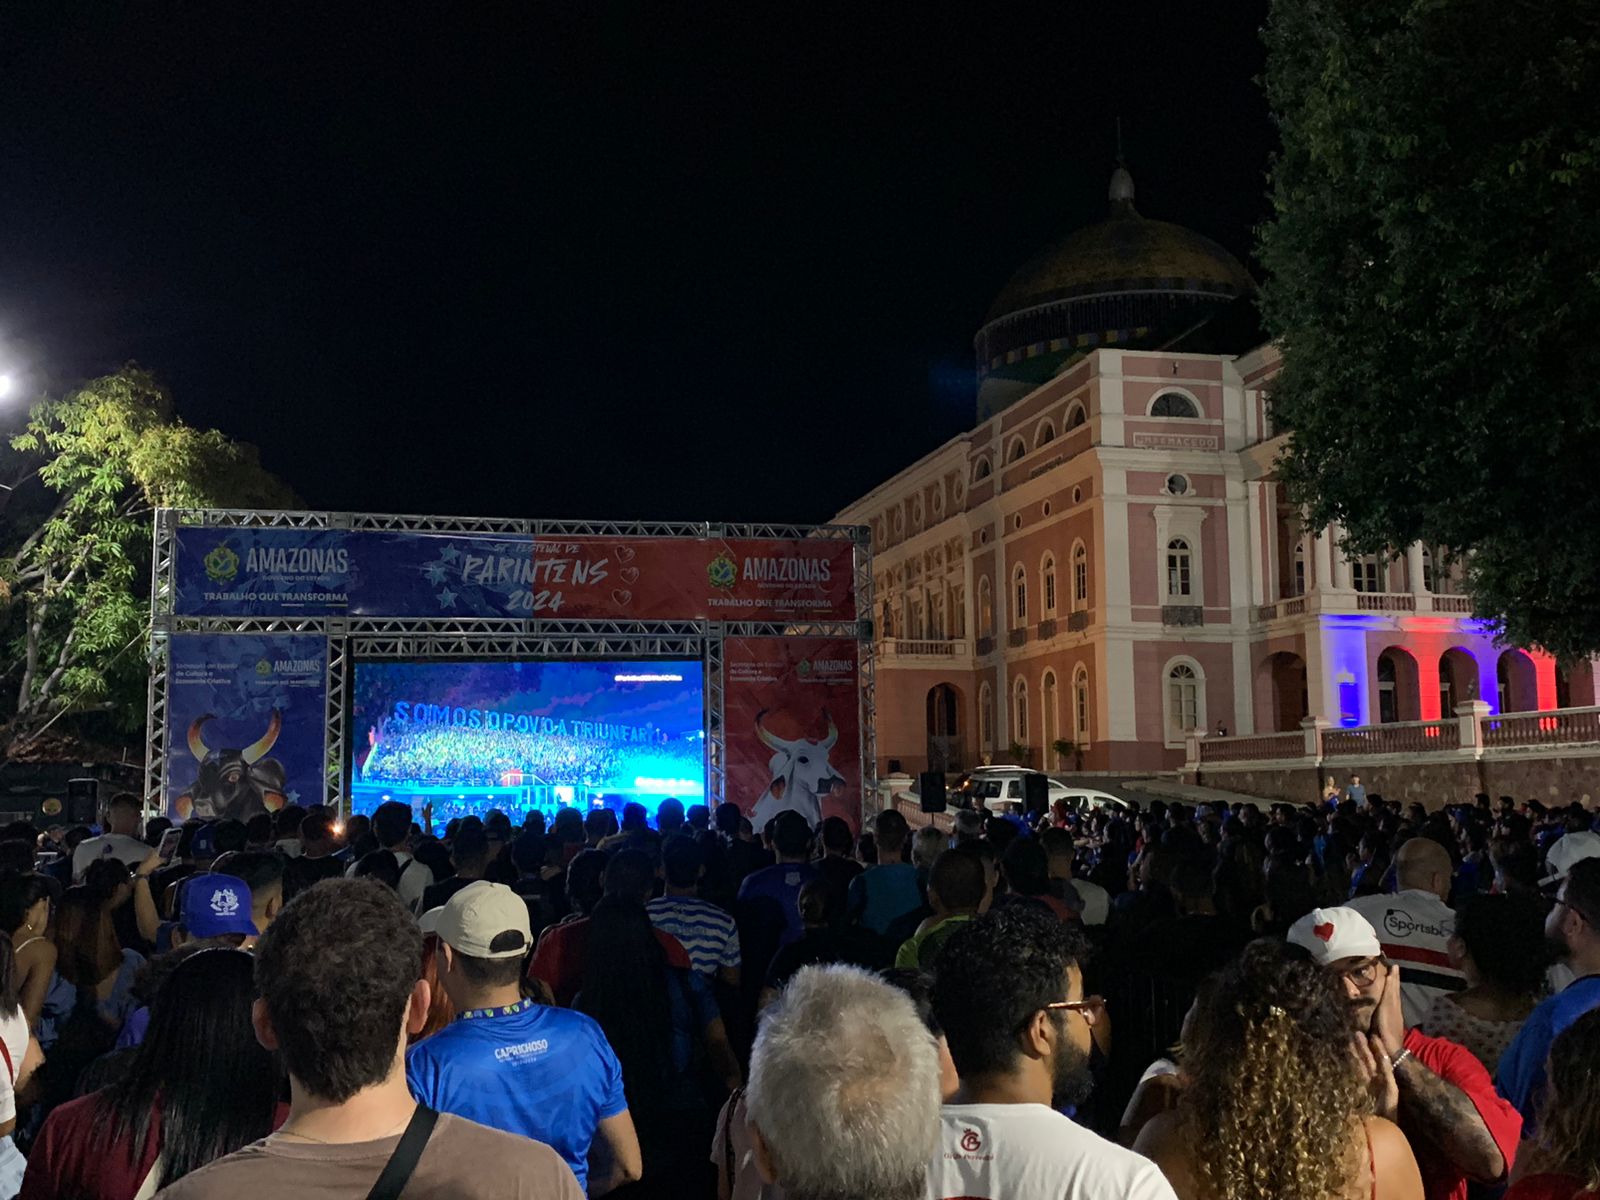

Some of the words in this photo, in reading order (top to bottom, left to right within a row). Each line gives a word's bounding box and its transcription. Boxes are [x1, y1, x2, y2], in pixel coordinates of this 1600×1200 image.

[246, 547, 349, 573] AMAZONAS
[743, 557, 831, 582] AMAZONAS
[204, 592, 257, 601] TRABALHO
[259, 592, 280, 601] QUE
[281, 592, 349, 602] TRANSFORMA
[505, 589, 565, 613] 2024
[707, 598, 754, 607] TRABALHO
[755, 599, 772, 608] QUE
[775, 599, 832, 608] TRANSFORMA
[273, 660, 320, 673] AMAZONAS
[813, 659, 854, 672] AMAZONAS
[394, 700, 482, 729] SOMOS
[494, 1038, 548, 1060] CAPRICHOSO
